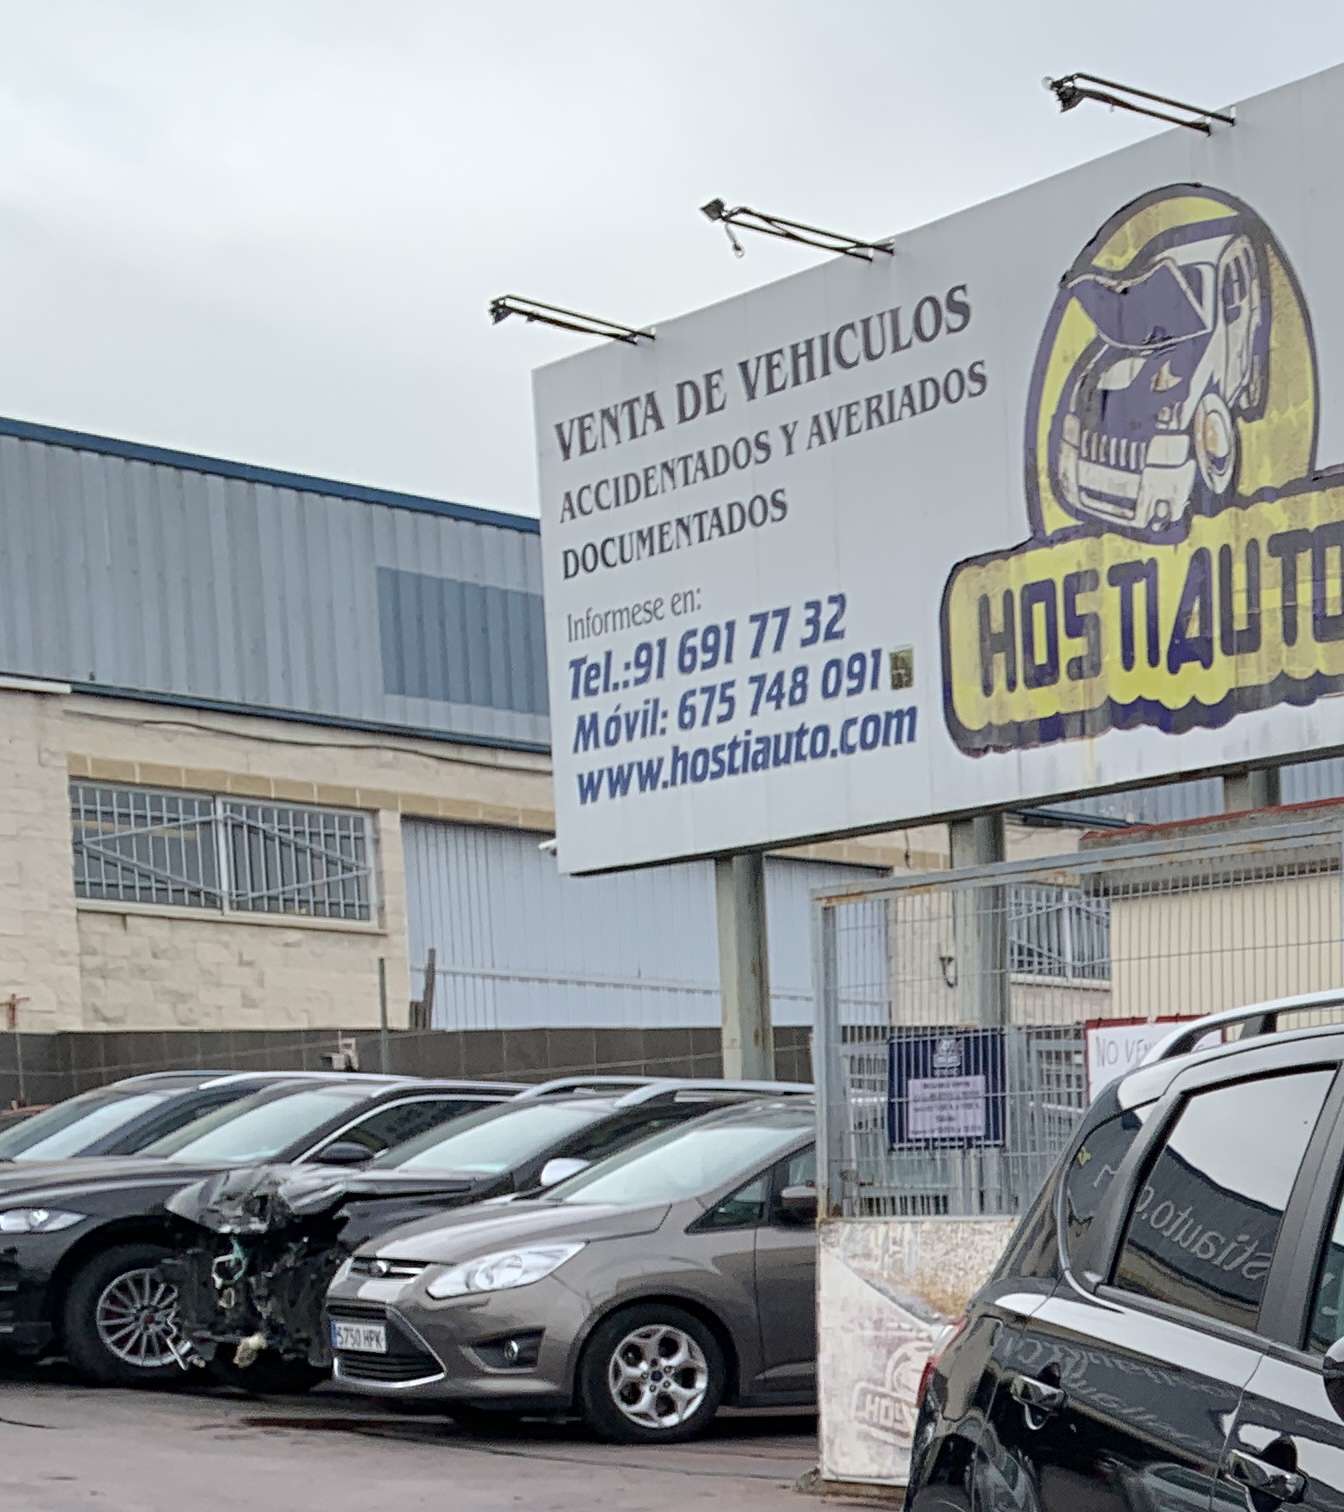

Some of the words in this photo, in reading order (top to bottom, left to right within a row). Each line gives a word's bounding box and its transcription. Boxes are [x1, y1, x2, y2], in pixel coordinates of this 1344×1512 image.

[554, 390, 665, 462] VENTA
[675, 368, 727, 425] DE
[737, 283, 973, 402] VEHICULOS
[560, 429, 771, 524] ACCIDENTADOS
[780, 420, 799, 457] Y
[806, 359, 989, 450] AVERIADOS
[561, 488, 789, 581] DOCUMENTADOS
[567, 597, 665, 643] Informese
[671, 586, 702, 616] en:
[677, 619, 737, 675] 691
[749, 606, 792, 660] 77
[800, 592, 848, 648] 32
[572, 697, 668, 754] Móvil:
[677, 679, 737, 731] 675
[748, 665, 810, 718] 748
[821, 647, 883, 701] 091
[576, 704, 918, 806] www.hostiauto.com
[1096, 1037, 1119, 1067] NO
